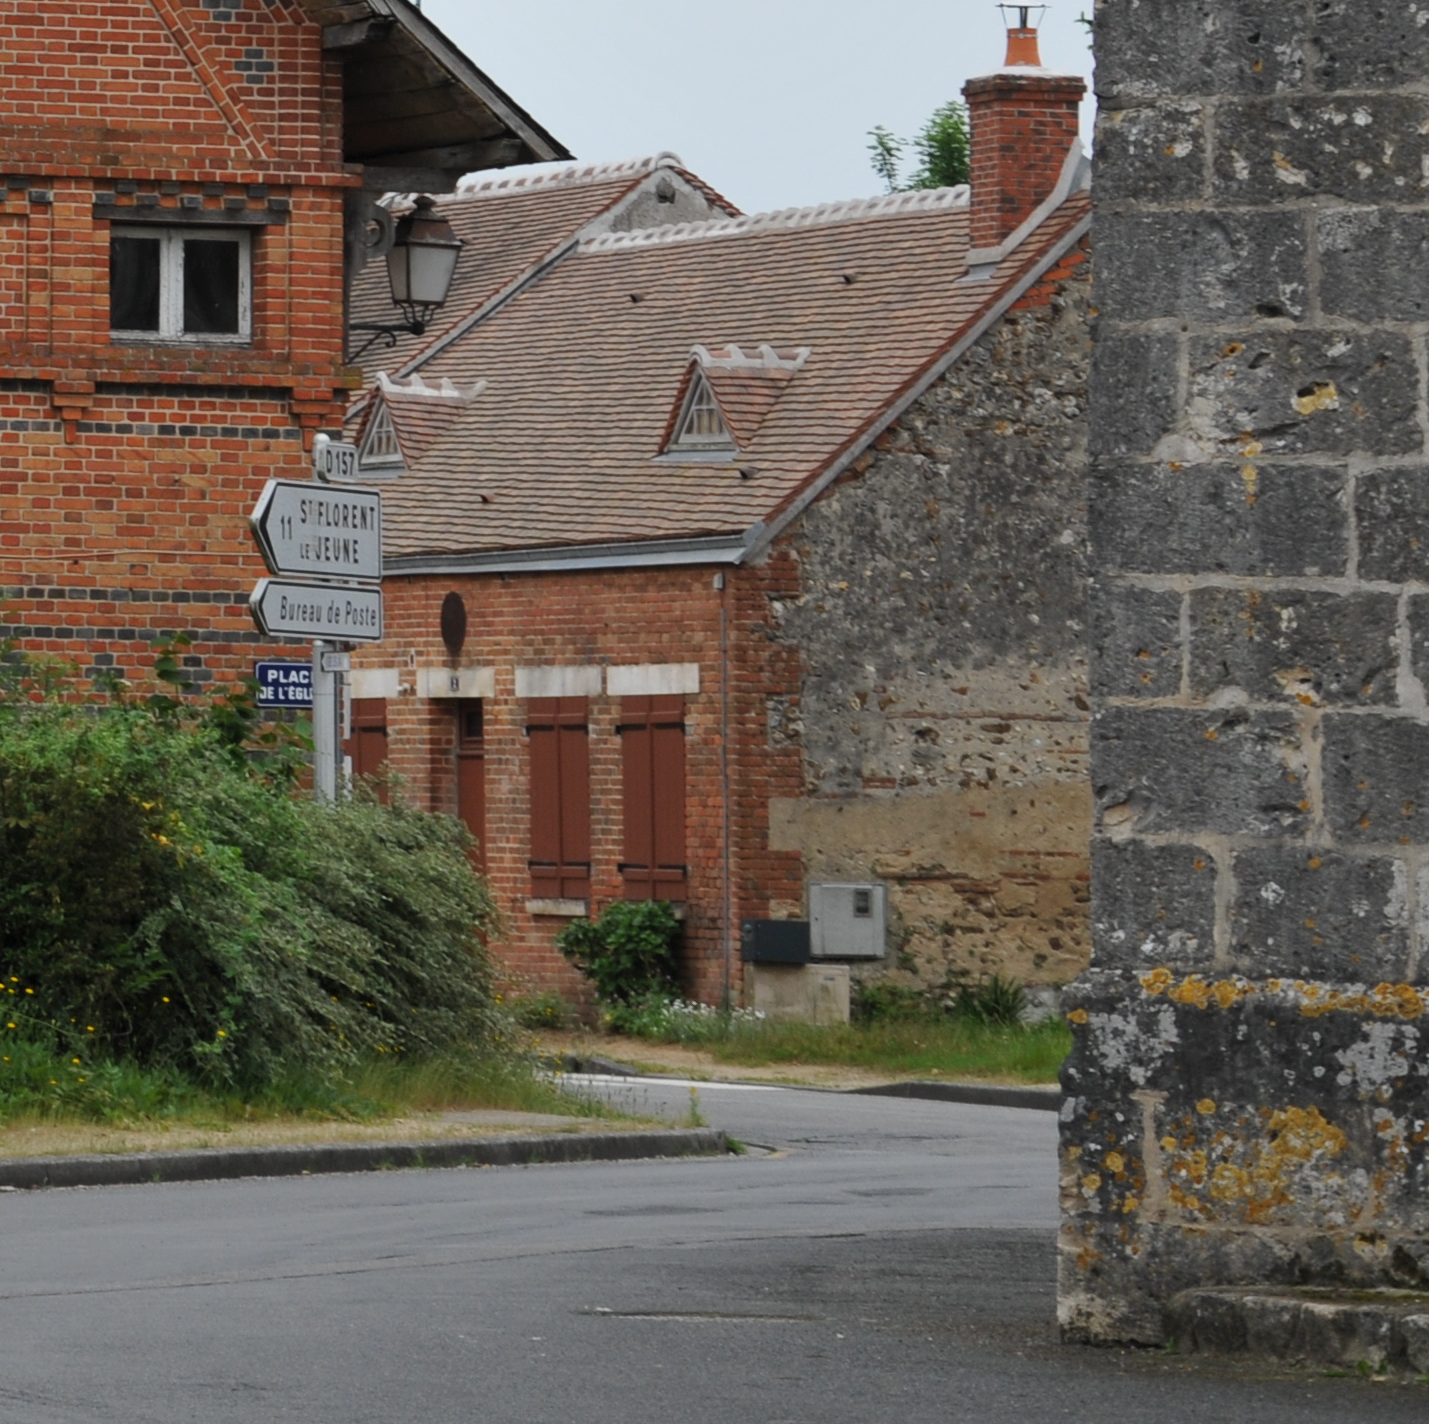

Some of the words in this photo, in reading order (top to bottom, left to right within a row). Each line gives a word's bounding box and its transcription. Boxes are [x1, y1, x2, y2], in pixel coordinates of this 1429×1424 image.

[326, 449, 333, 474] D
[336, 450, 355, 475] 157
[280, 515, 292, 540] 11
[318, 501, 375, 531] FLORENT
[300, 543, 310, 560] LE
[315, 536, 359, 564] JEUNE
[280, 595, 322, 623] Bureau
[327, 599, 341, 624] de
[344, 600, 376, 627] Poste
[267, 670, 313, 683] PLAC
[259, 686, 275, 699] DE
[278, 685, 313, 700] L'ÉGLI
